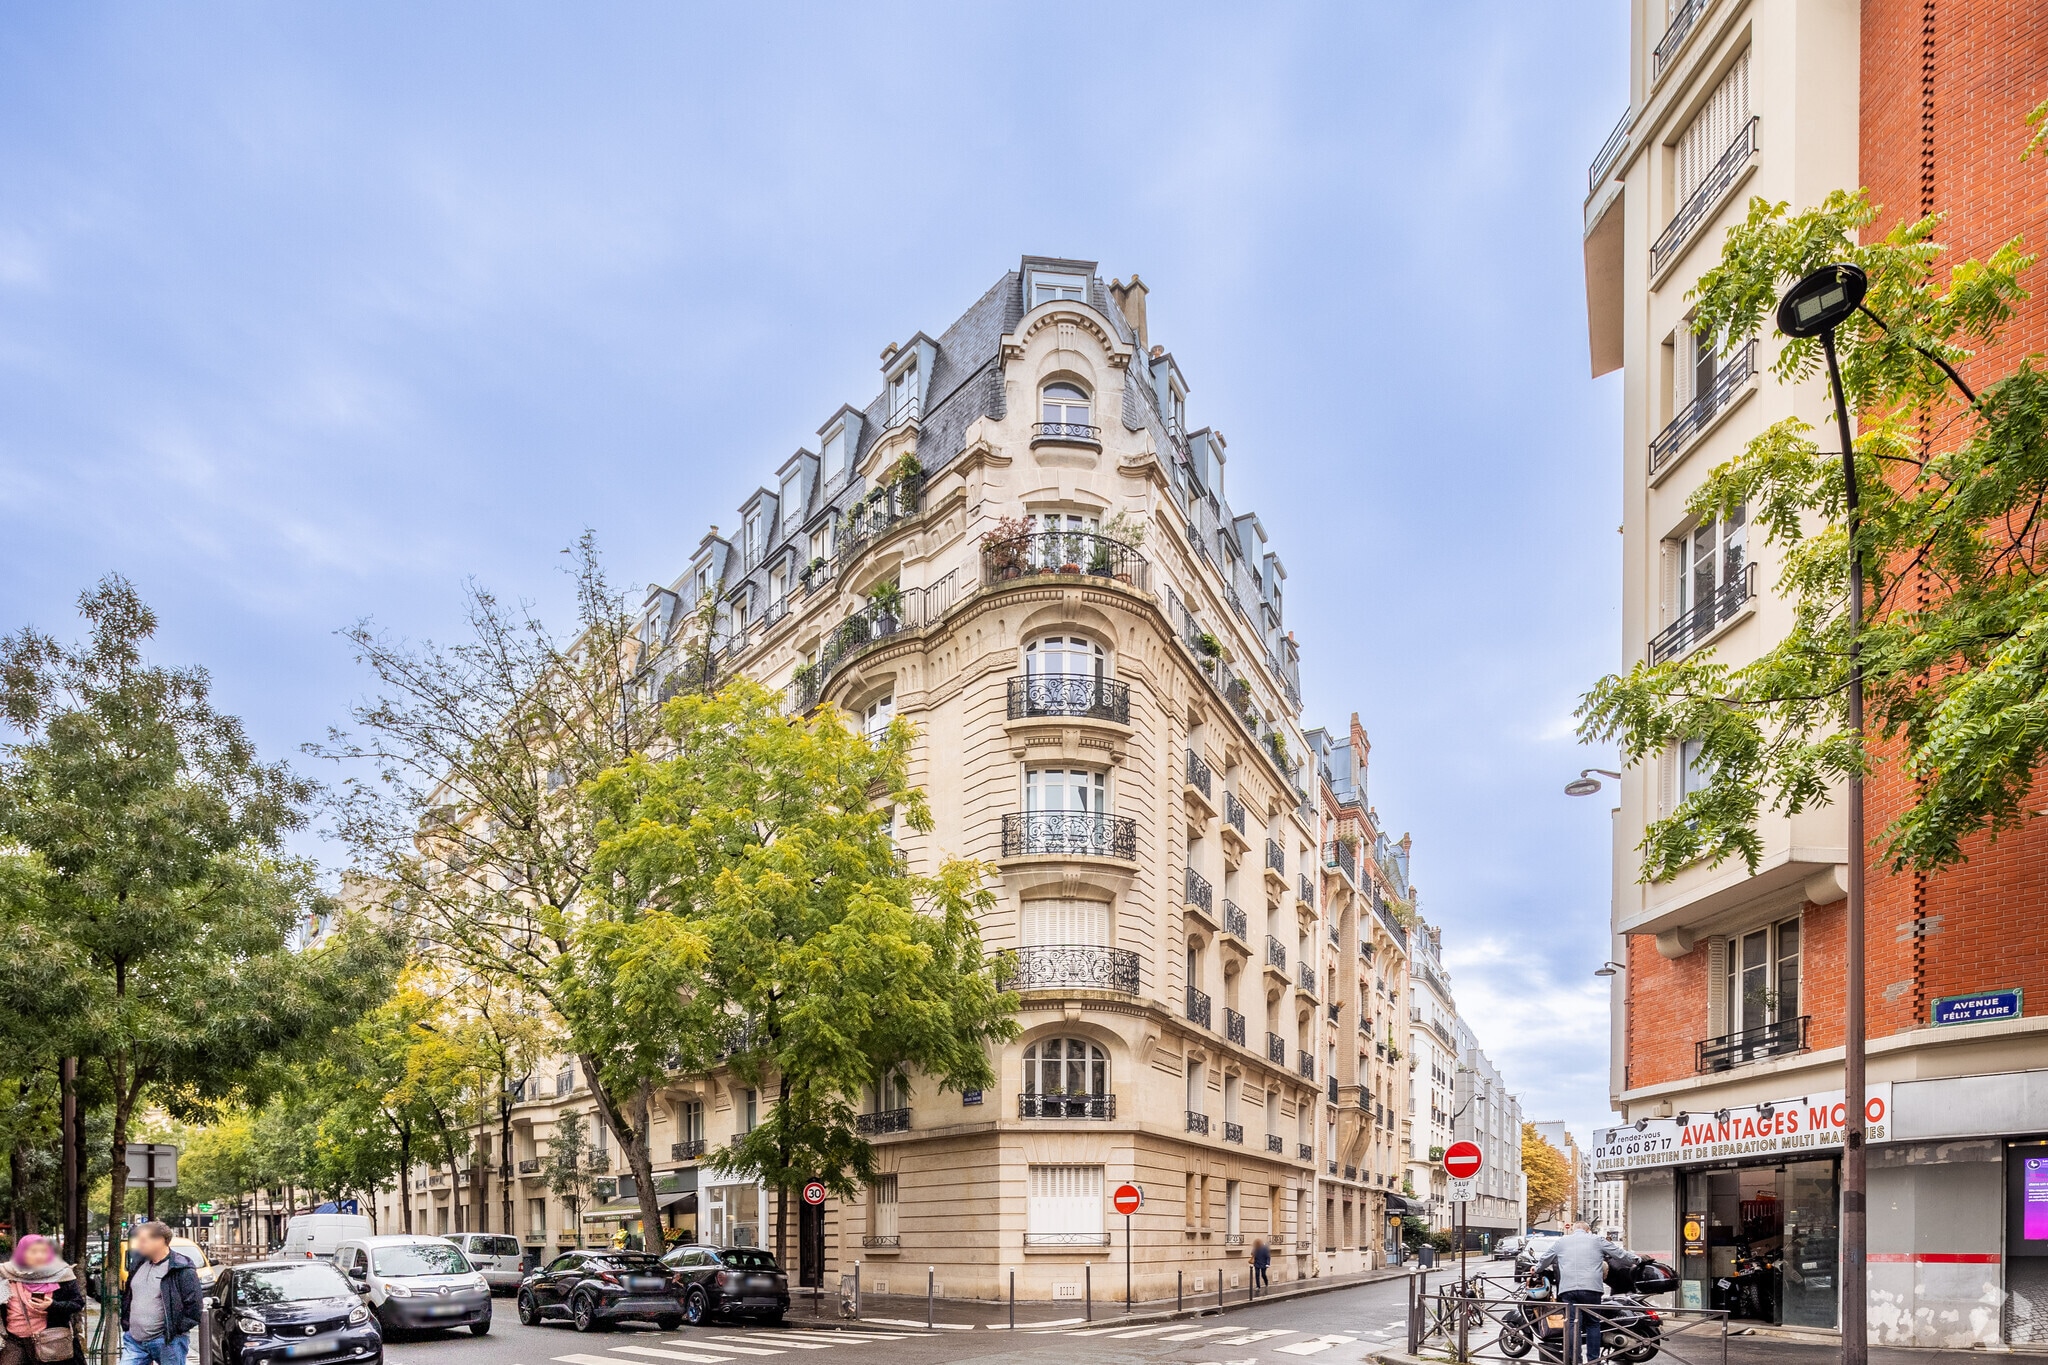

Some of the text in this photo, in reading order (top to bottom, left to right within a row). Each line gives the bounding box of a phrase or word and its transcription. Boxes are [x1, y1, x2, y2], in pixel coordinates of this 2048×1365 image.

[1953, 997, 1999, 1010] AVENUE
[1943, 1006, 2010, 1021] FÉLIX FAURE
[1681, 1097, 1885, 1147] AVANTAGES MOO
[1617, 1131, 1661, 1143] rendez-vous
[1596, 1138, 1672, 1158] 01 40 60 87 17
[1596, 1158, 1625, 1170] ATELIER
[1628, 1150, 1680, 1167] D'ENTRETIEN
[1682, 1148, 1693, 1160] ET
[1695, 1146, 1708, 1159] DE
[1711, 1138, 1777, 1157] REPARATION
[1781, 1133, 1815, 1149] MULTI
[808, 1188, 821, 1199] 30
